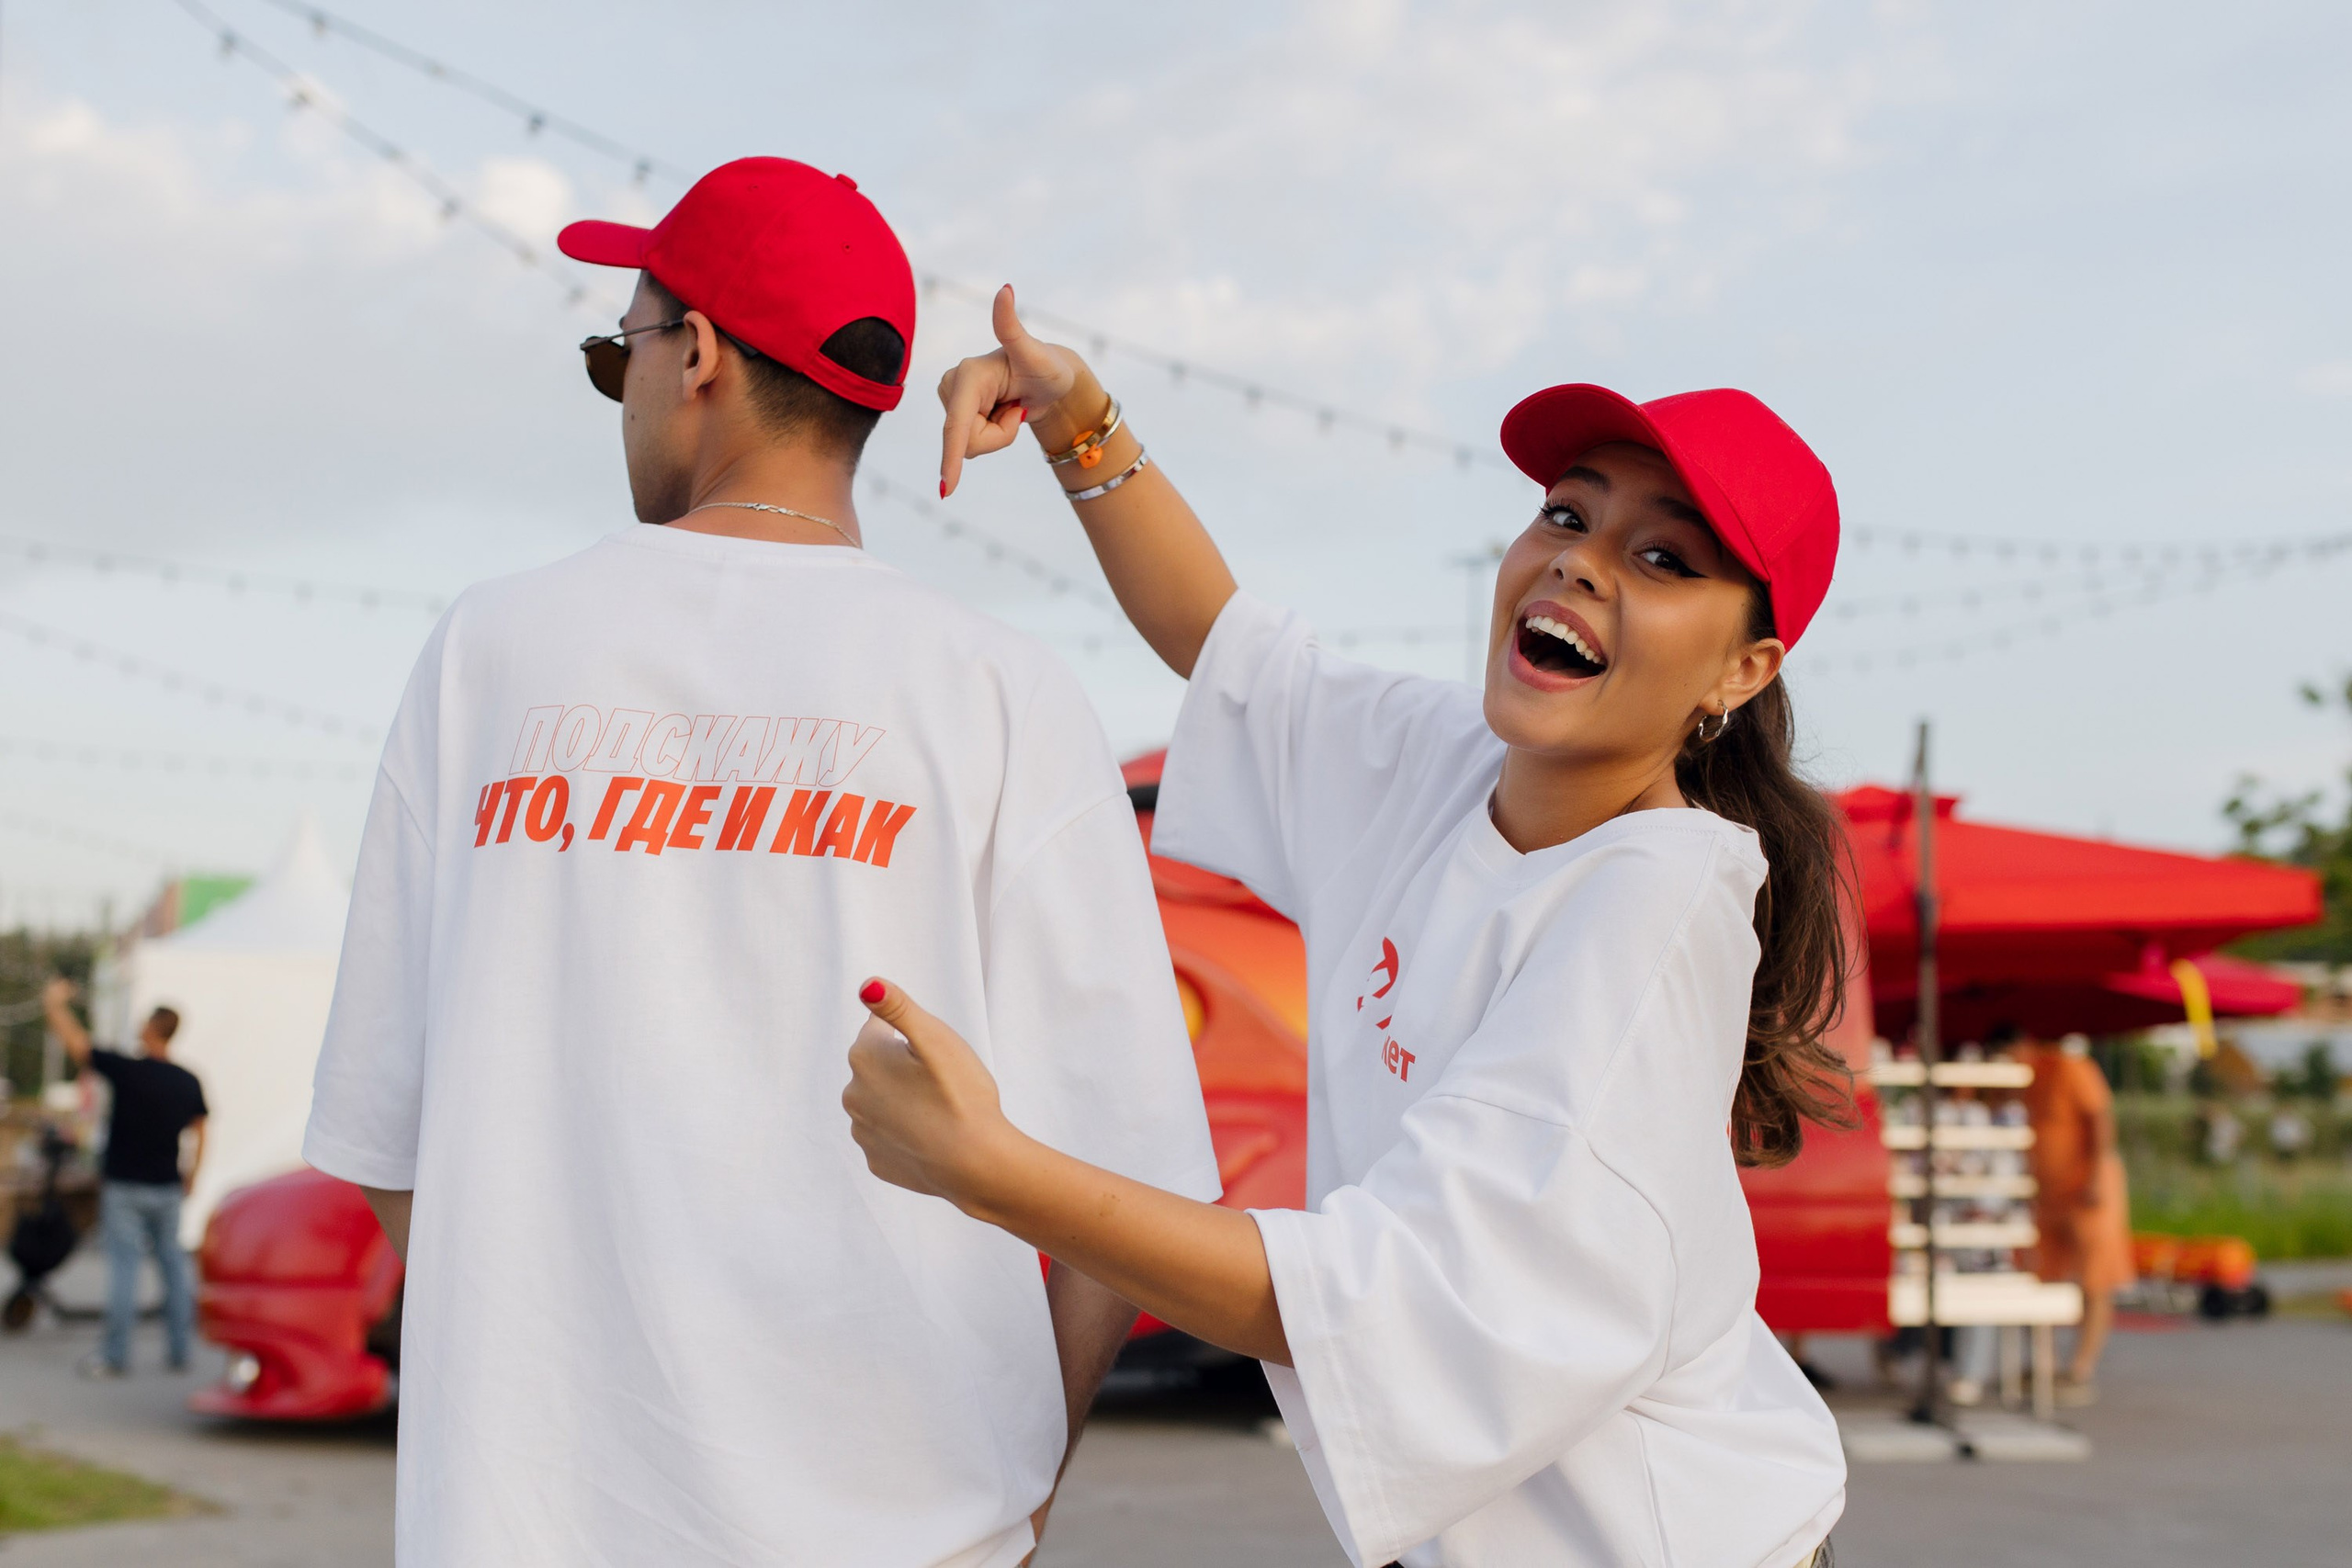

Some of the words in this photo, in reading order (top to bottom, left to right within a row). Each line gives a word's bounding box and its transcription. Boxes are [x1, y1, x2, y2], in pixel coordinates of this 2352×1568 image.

[509, 705, 887, 787] ПОДСКАЖУ
[474, 775, 575, 852] ЧТО,
[587, 776, 722, 856] ГДЕ
[715, 785, 778, 852] И
[769, 789, 917, 868] КАК
